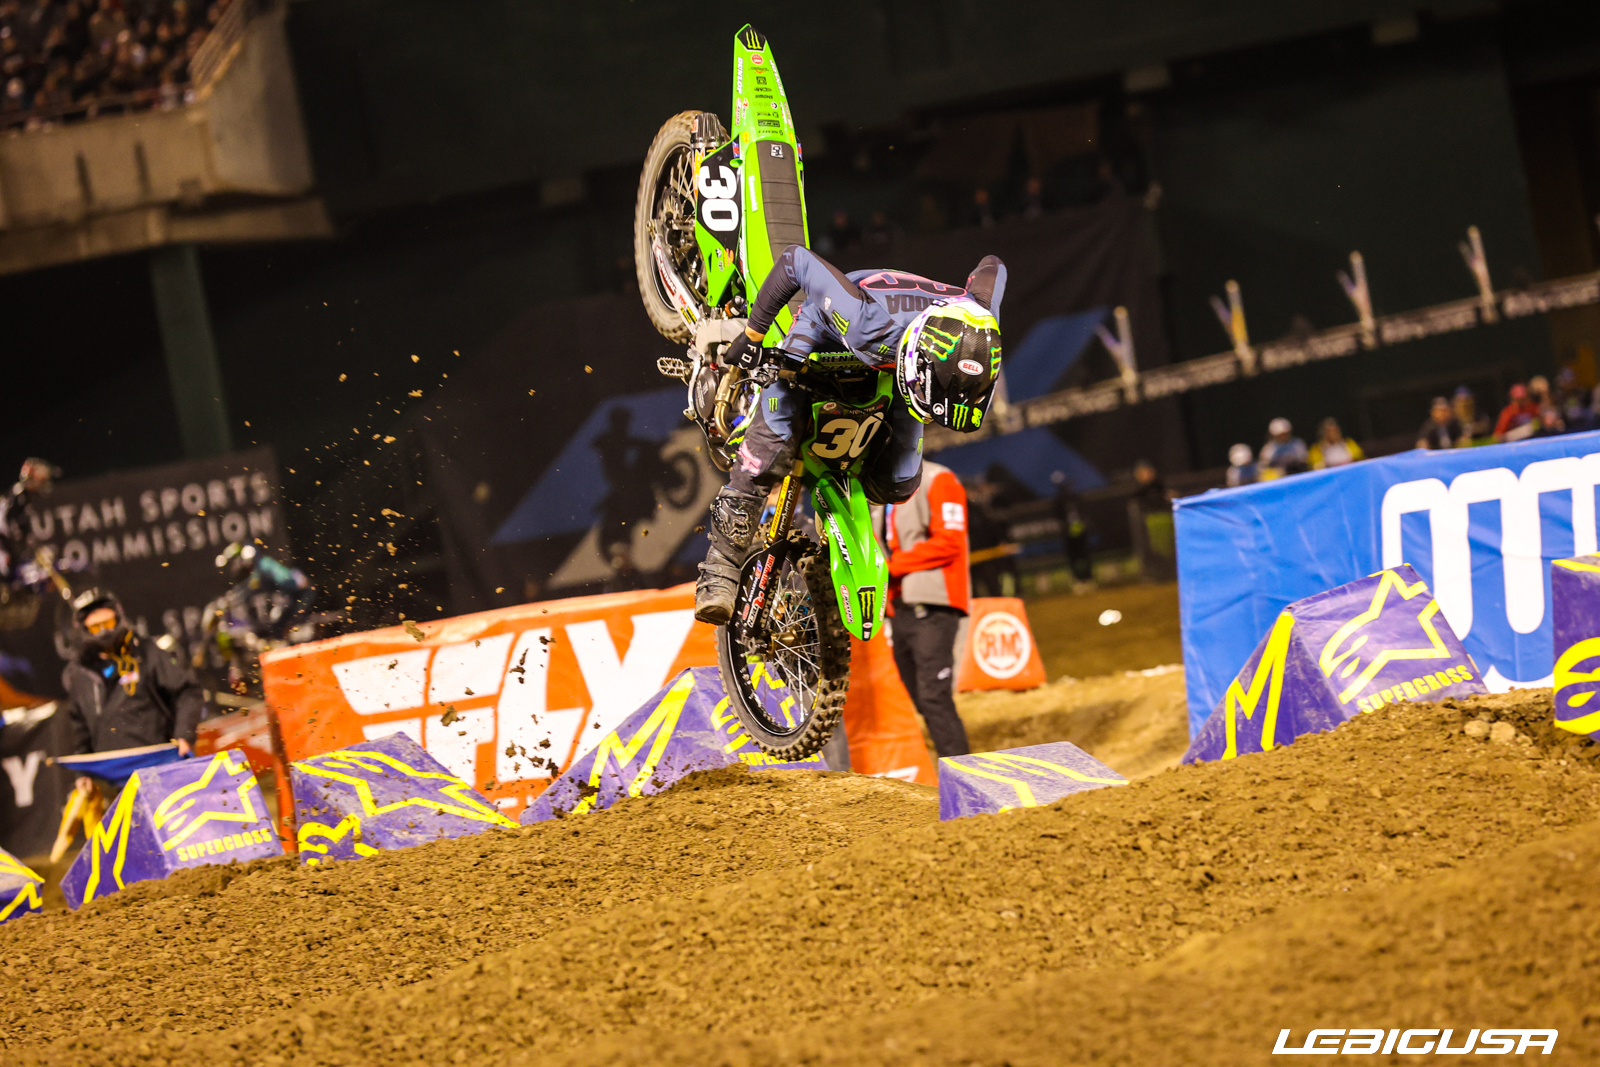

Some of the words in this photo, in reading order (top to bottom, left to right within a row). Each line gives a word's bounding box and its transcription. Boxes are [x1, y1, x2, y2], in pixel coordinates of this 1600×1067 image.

[698, 165, 739, 231] 30
[821, 354, 861, 363] RENT
[962, 362, 980, 373] BELL
[811, 412, 885, 459] 30
[140, 472, 271, 522] SPORTS
[60, 509, 273, 572] OMMISSION
[826, 511, 853, 566] CIRCUIT
[1356, 665, 1474, 714] SUPERCROSS
[176, 828, 273, 861] SUPERCROSS
